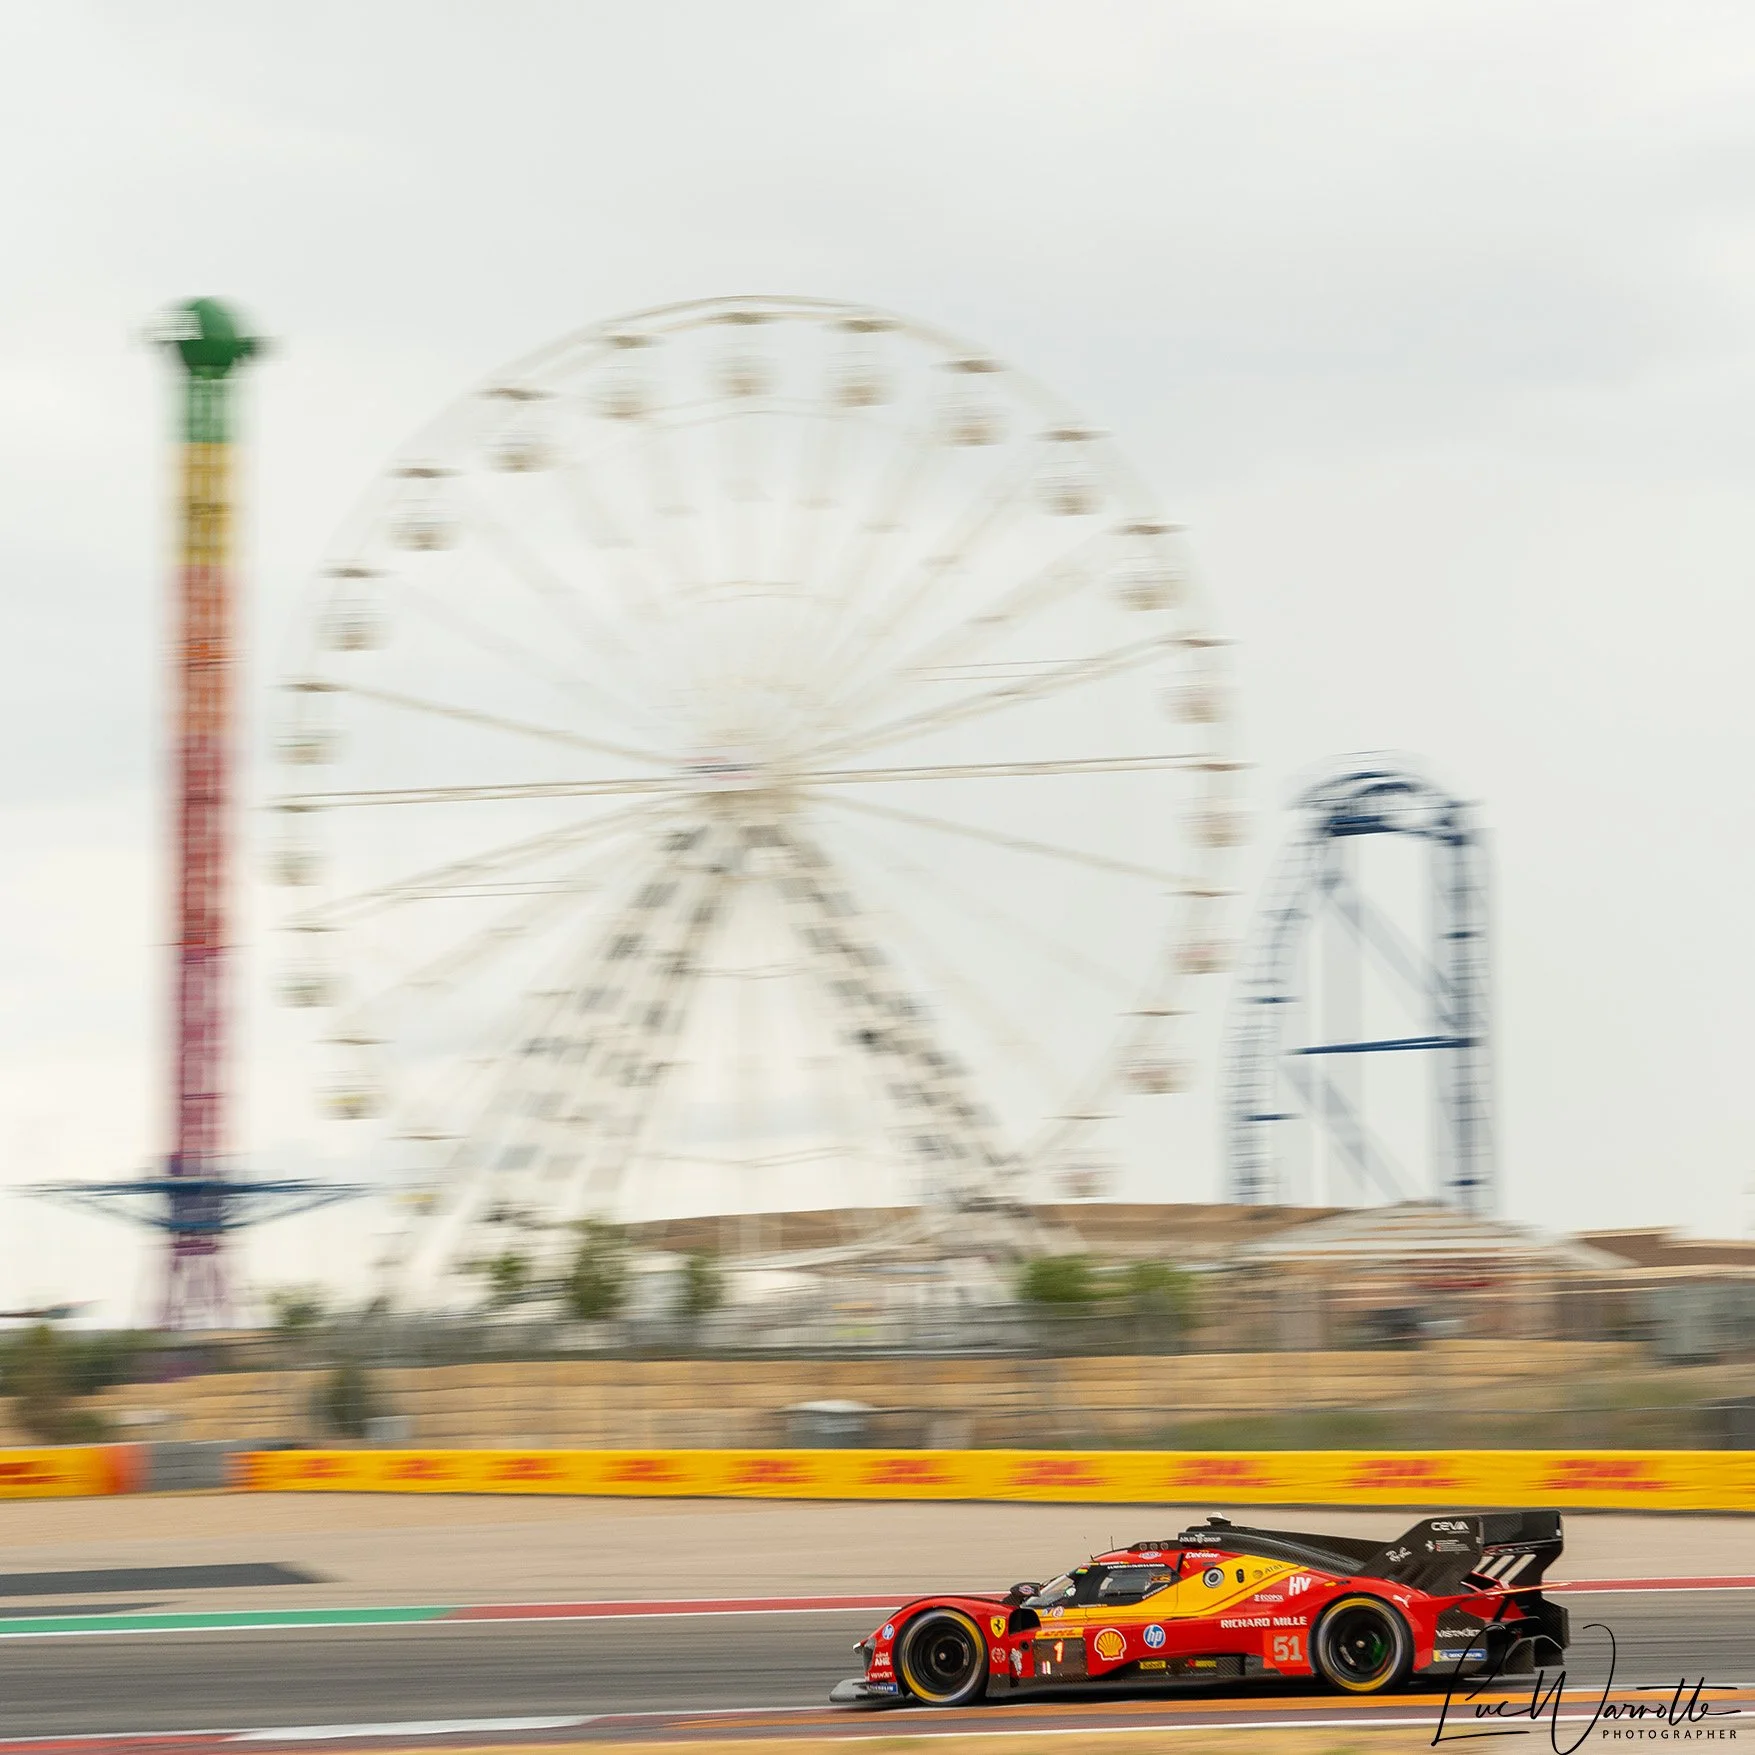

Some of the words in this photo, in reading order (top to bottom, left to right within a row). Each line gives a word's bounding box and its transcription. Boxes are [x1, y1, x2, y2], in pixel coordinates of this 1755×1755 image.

[1430, 1521, 1470, 1531] CEVA
[1220, 1617, 1270, 1629] RICHARD
[1273, 1616, 1308, 1626] MILLE
[1145, 1625, 1164, 1648] hp
[1273, 1635, 1303, 1661] 51
[1054, 1640, 1065, 1663] 1
